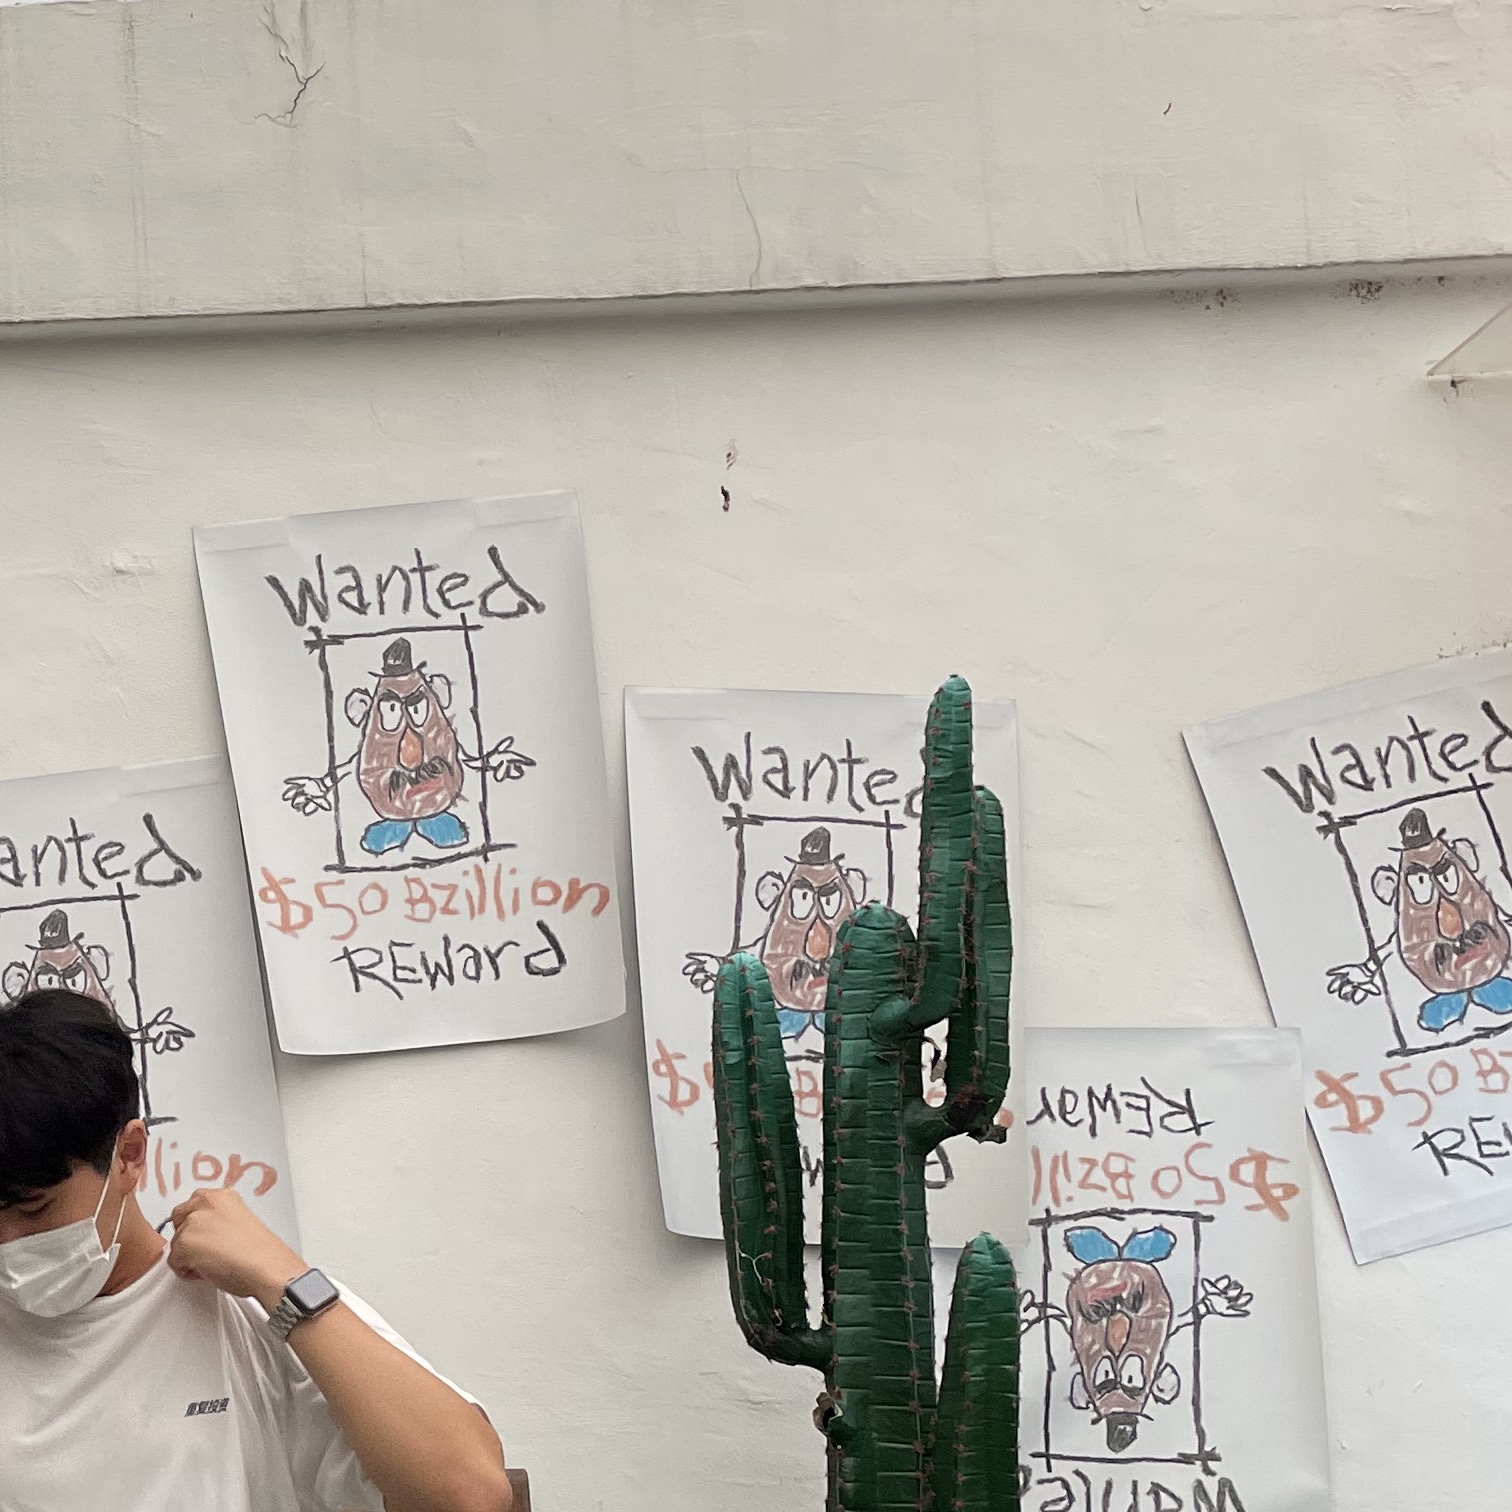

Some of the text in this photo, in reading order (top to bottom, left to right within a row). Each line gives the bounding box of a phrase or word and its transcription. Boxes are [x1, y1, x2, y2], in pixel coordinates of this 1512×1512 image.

[264, 545, 546, 628] Wanted
[258, 867, 390, 941] $50
[1314, 1059, 1460, 1134] $50
